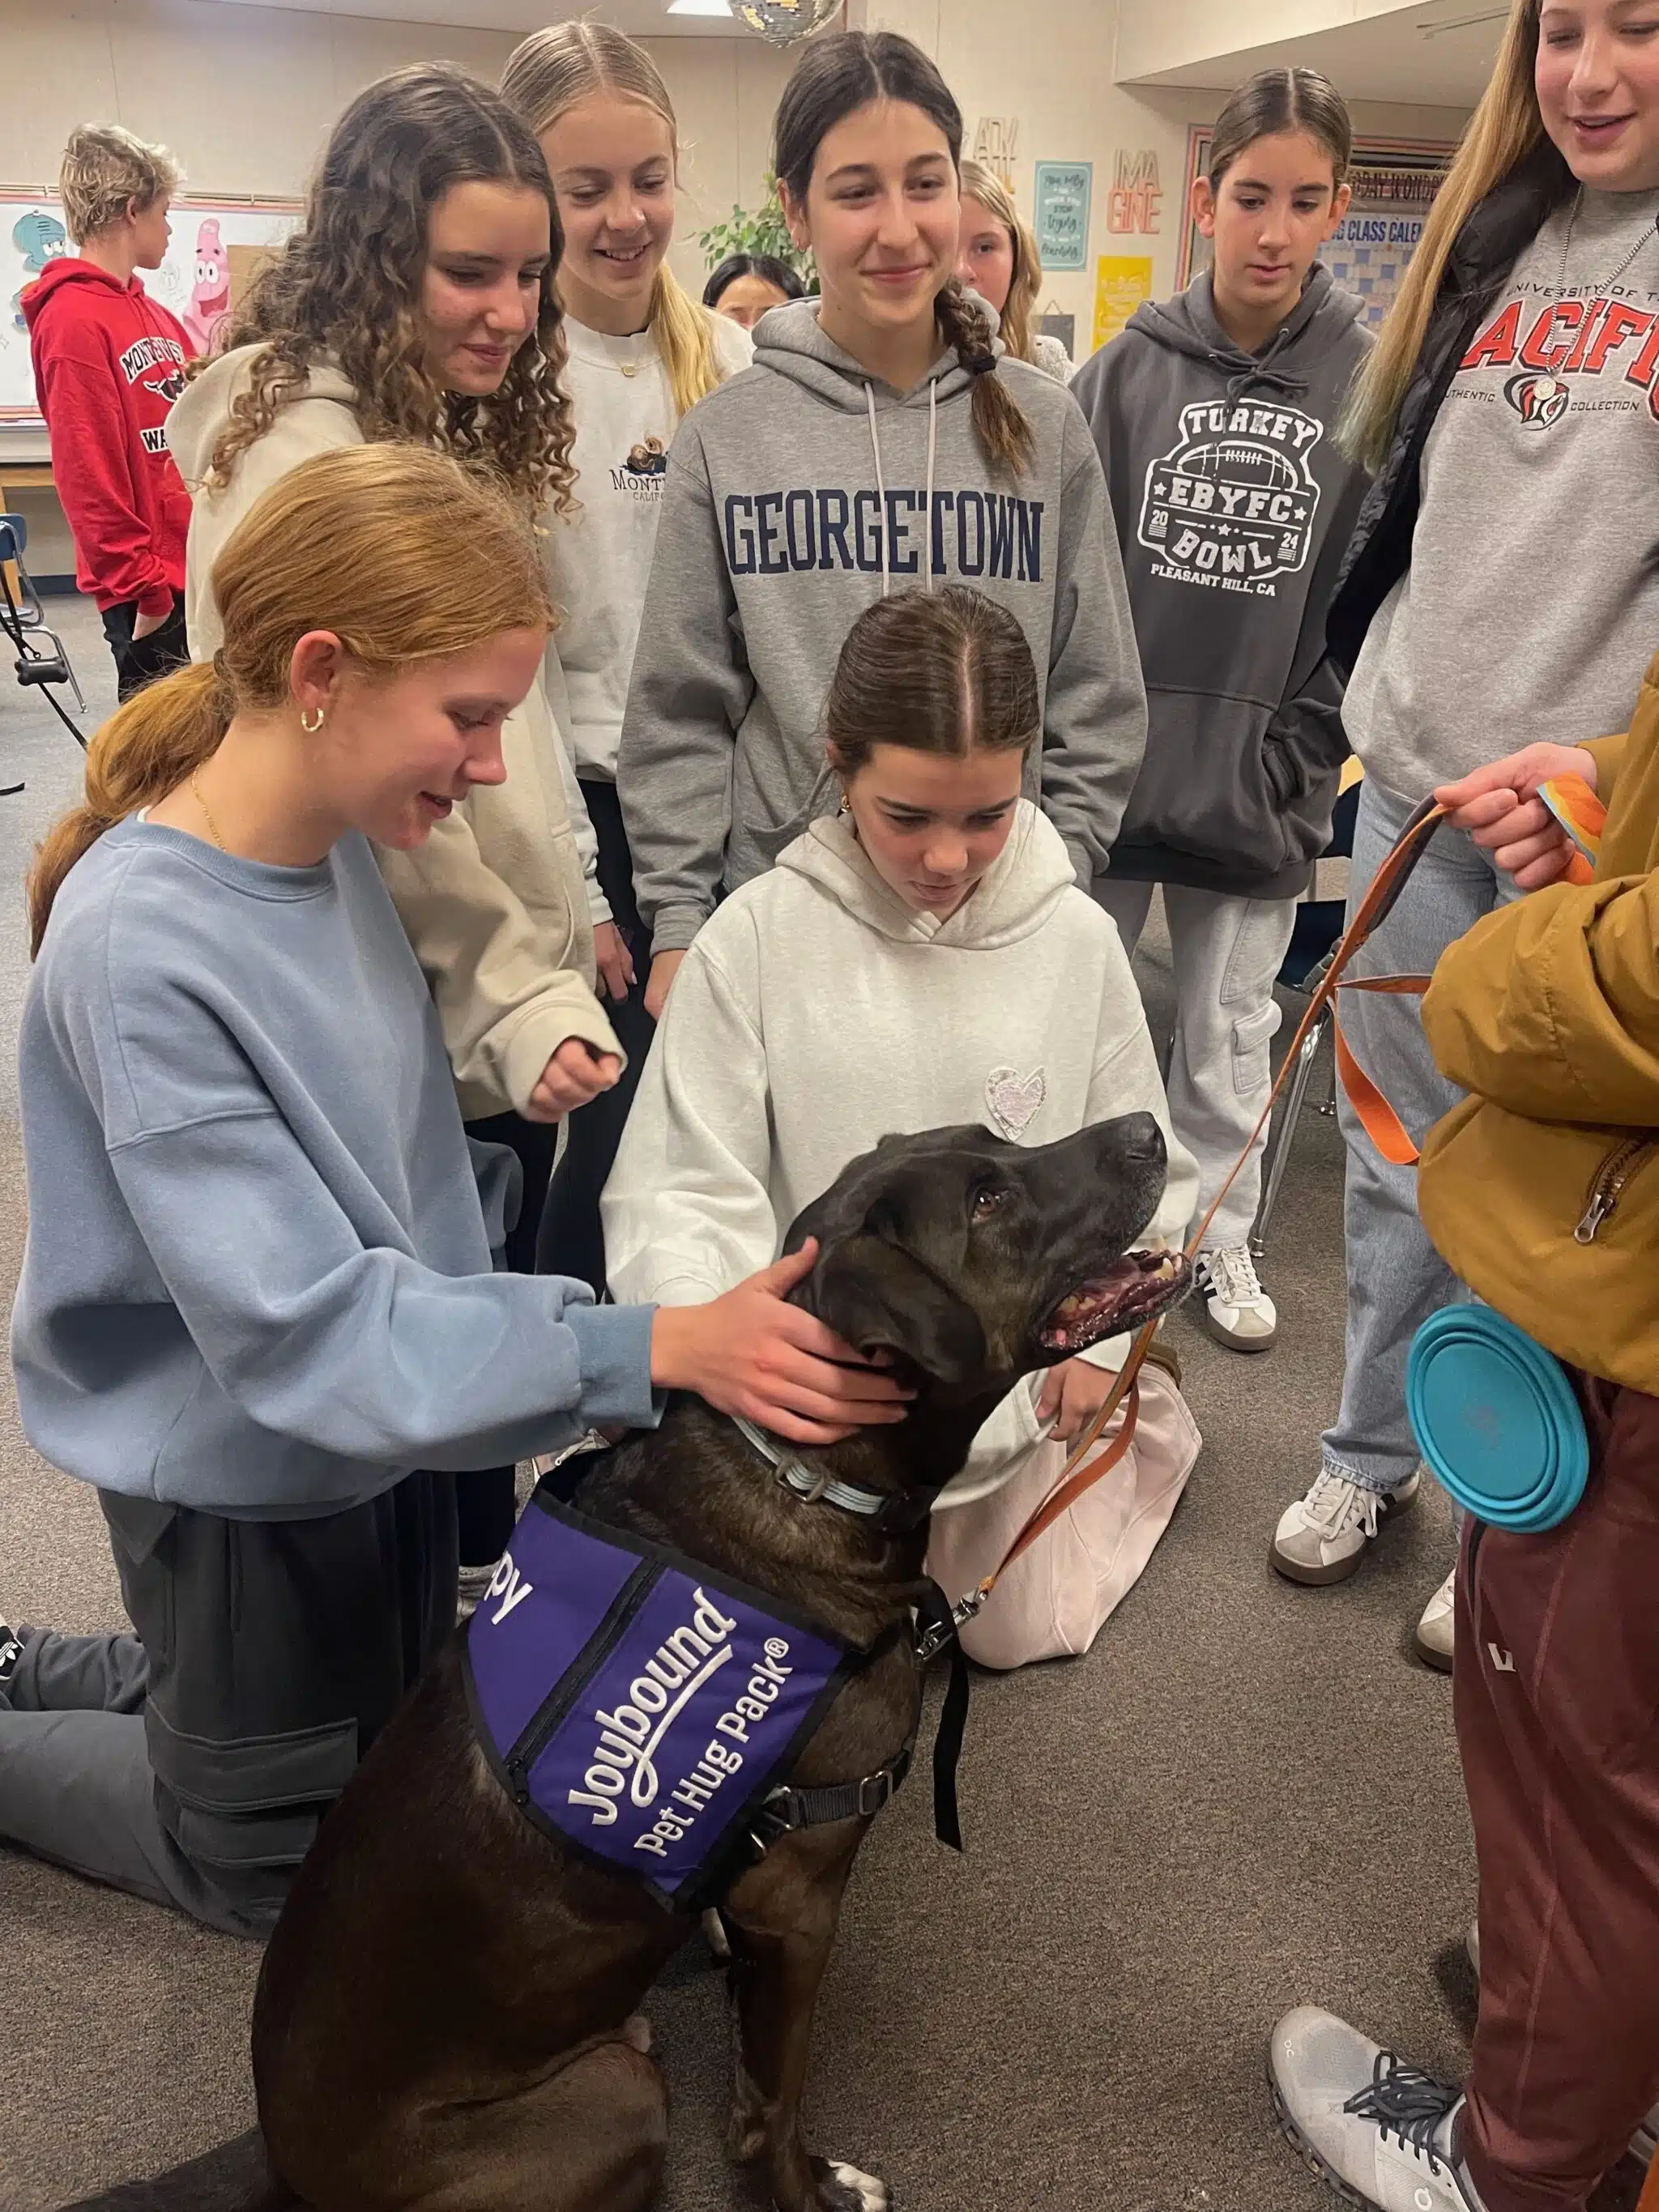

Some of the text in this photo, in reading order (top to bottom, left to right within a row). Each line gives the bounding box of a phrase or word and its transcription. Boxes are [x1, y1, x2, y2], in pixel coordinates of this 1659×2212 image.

[1348, 220, 1387, 241] CLASS
[1611, 285, 1638, 298] OF
[1648, 292, 1659, 302] T
[1458, 299, 1659, 421] ACIFI
[1571, 401, 1640, 411] COLLECTION
[1188, 407, 1316, 448] TURKEY
[609, 470, 665, 491] MONT
[1168, 477, 1293, 522] EBYFC
[725, 489, 1044, 582] GEORGETOWN
[1151, 509, 1169, 526] 20
[1172, 528, 1273, 573] BOWL
[1280, 531, 1299, 549] 24
[1150, 564, 1276, 597] PLEASANT HILL, CA
[484, 1550, 534, 1626] py
[568, 1586, 737, 1826] Joybound
[633, 1805, 695, 1858] Pet
[671, 1738, 744, 1812] Hug
